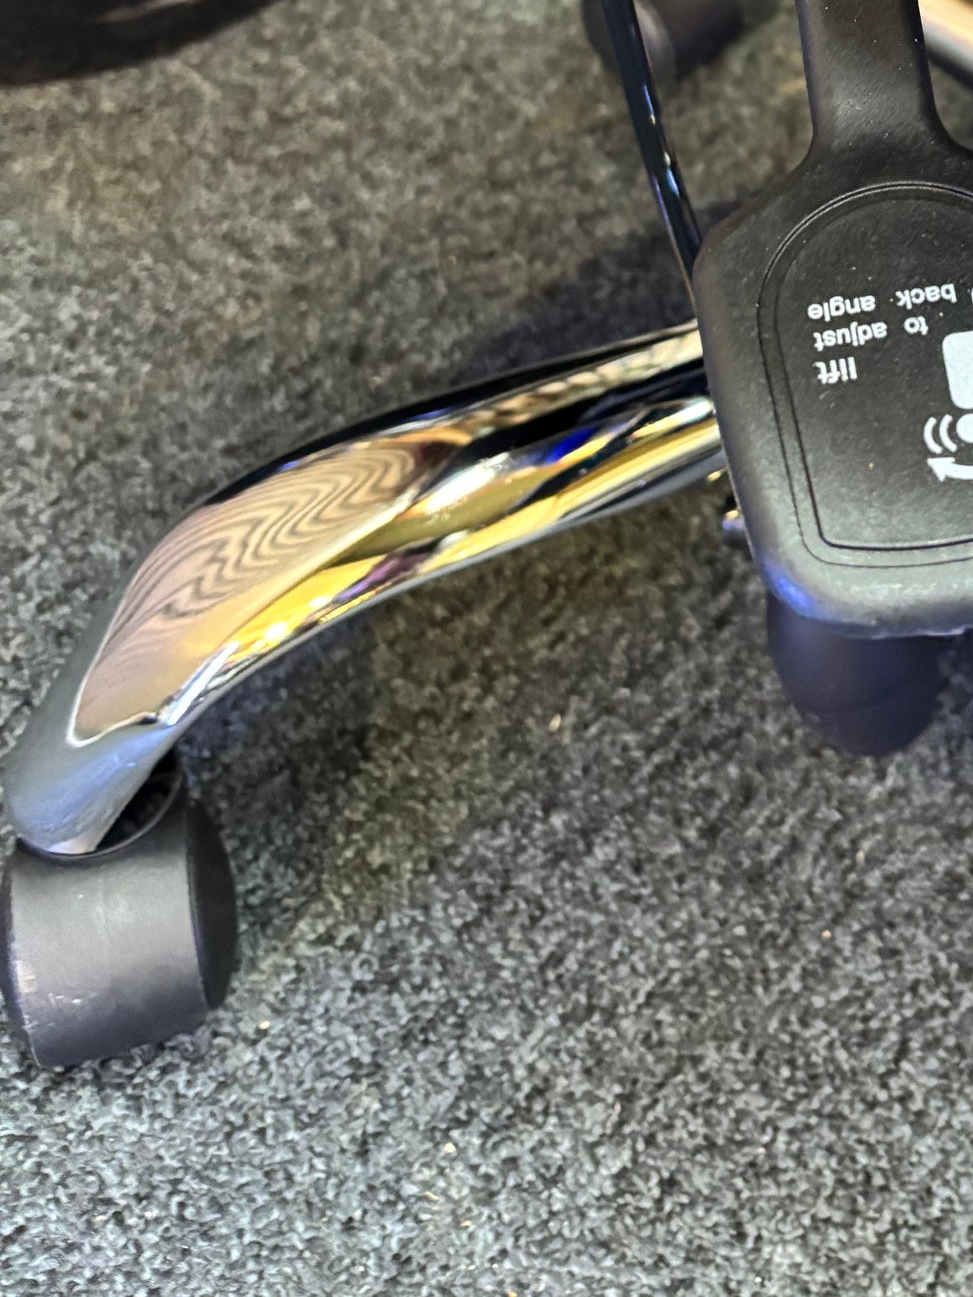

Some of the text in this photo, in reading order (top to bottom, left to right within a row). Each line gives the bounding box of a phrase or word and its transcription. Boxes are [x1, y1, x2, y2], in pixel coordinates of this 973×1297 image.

[807, 283, 957, 322] back angle
[812, 315, 929, 351] to adjust
[812, 356, 858, 385] lift
